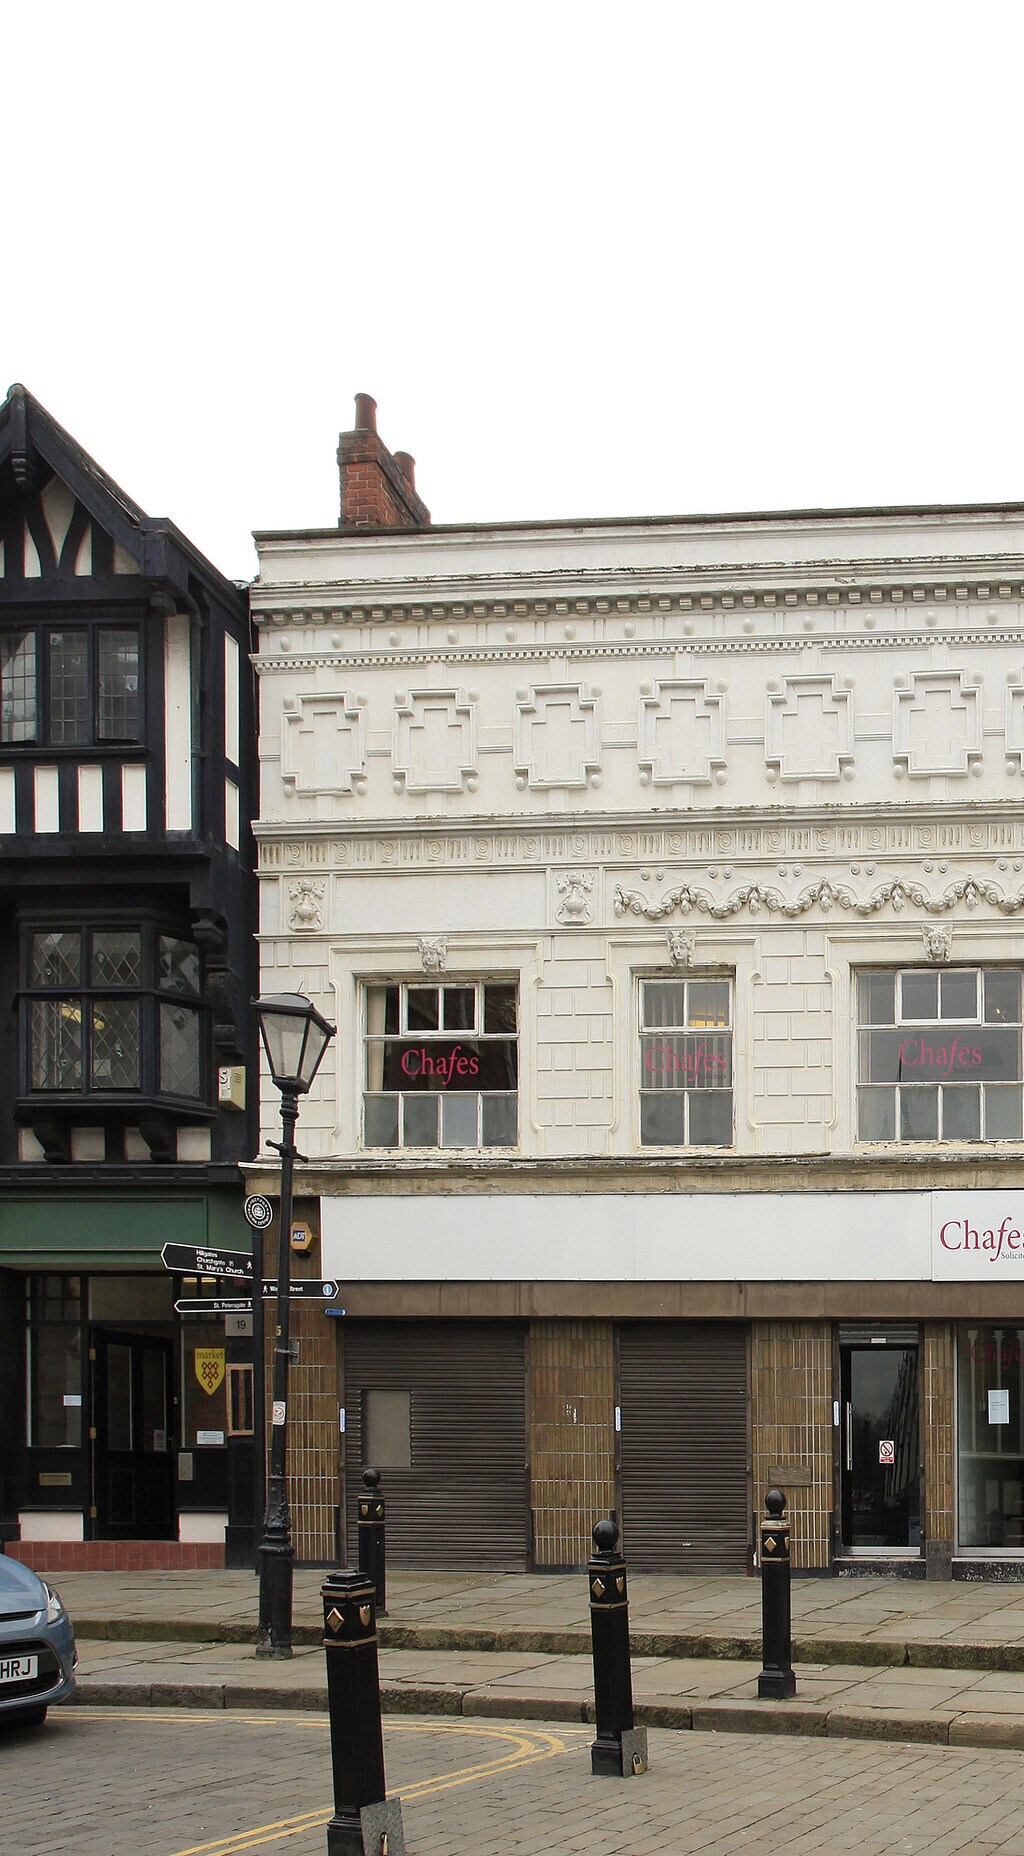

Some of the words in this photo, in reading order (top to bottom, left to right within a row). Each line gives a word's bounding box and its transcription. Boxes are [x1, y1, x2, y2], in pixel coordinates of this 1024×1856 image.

[900, 1035, 982, 1076] Chafes
[401, 1046, 479, 1085] Chafes
[645, 1042, 727, 1082] Chafes
[292, 1232, 305, 1240] ADT
[196, 1256, 226, 1266] Churchgate
[206, 1264, 224, 1272] Mary's
[225, 1266, 244, 1275] Church
[236, 1320, 246, 1329] 19
[196, 1350, 224, 1359] market
[0, 1658, 31, 1679] HRJ
